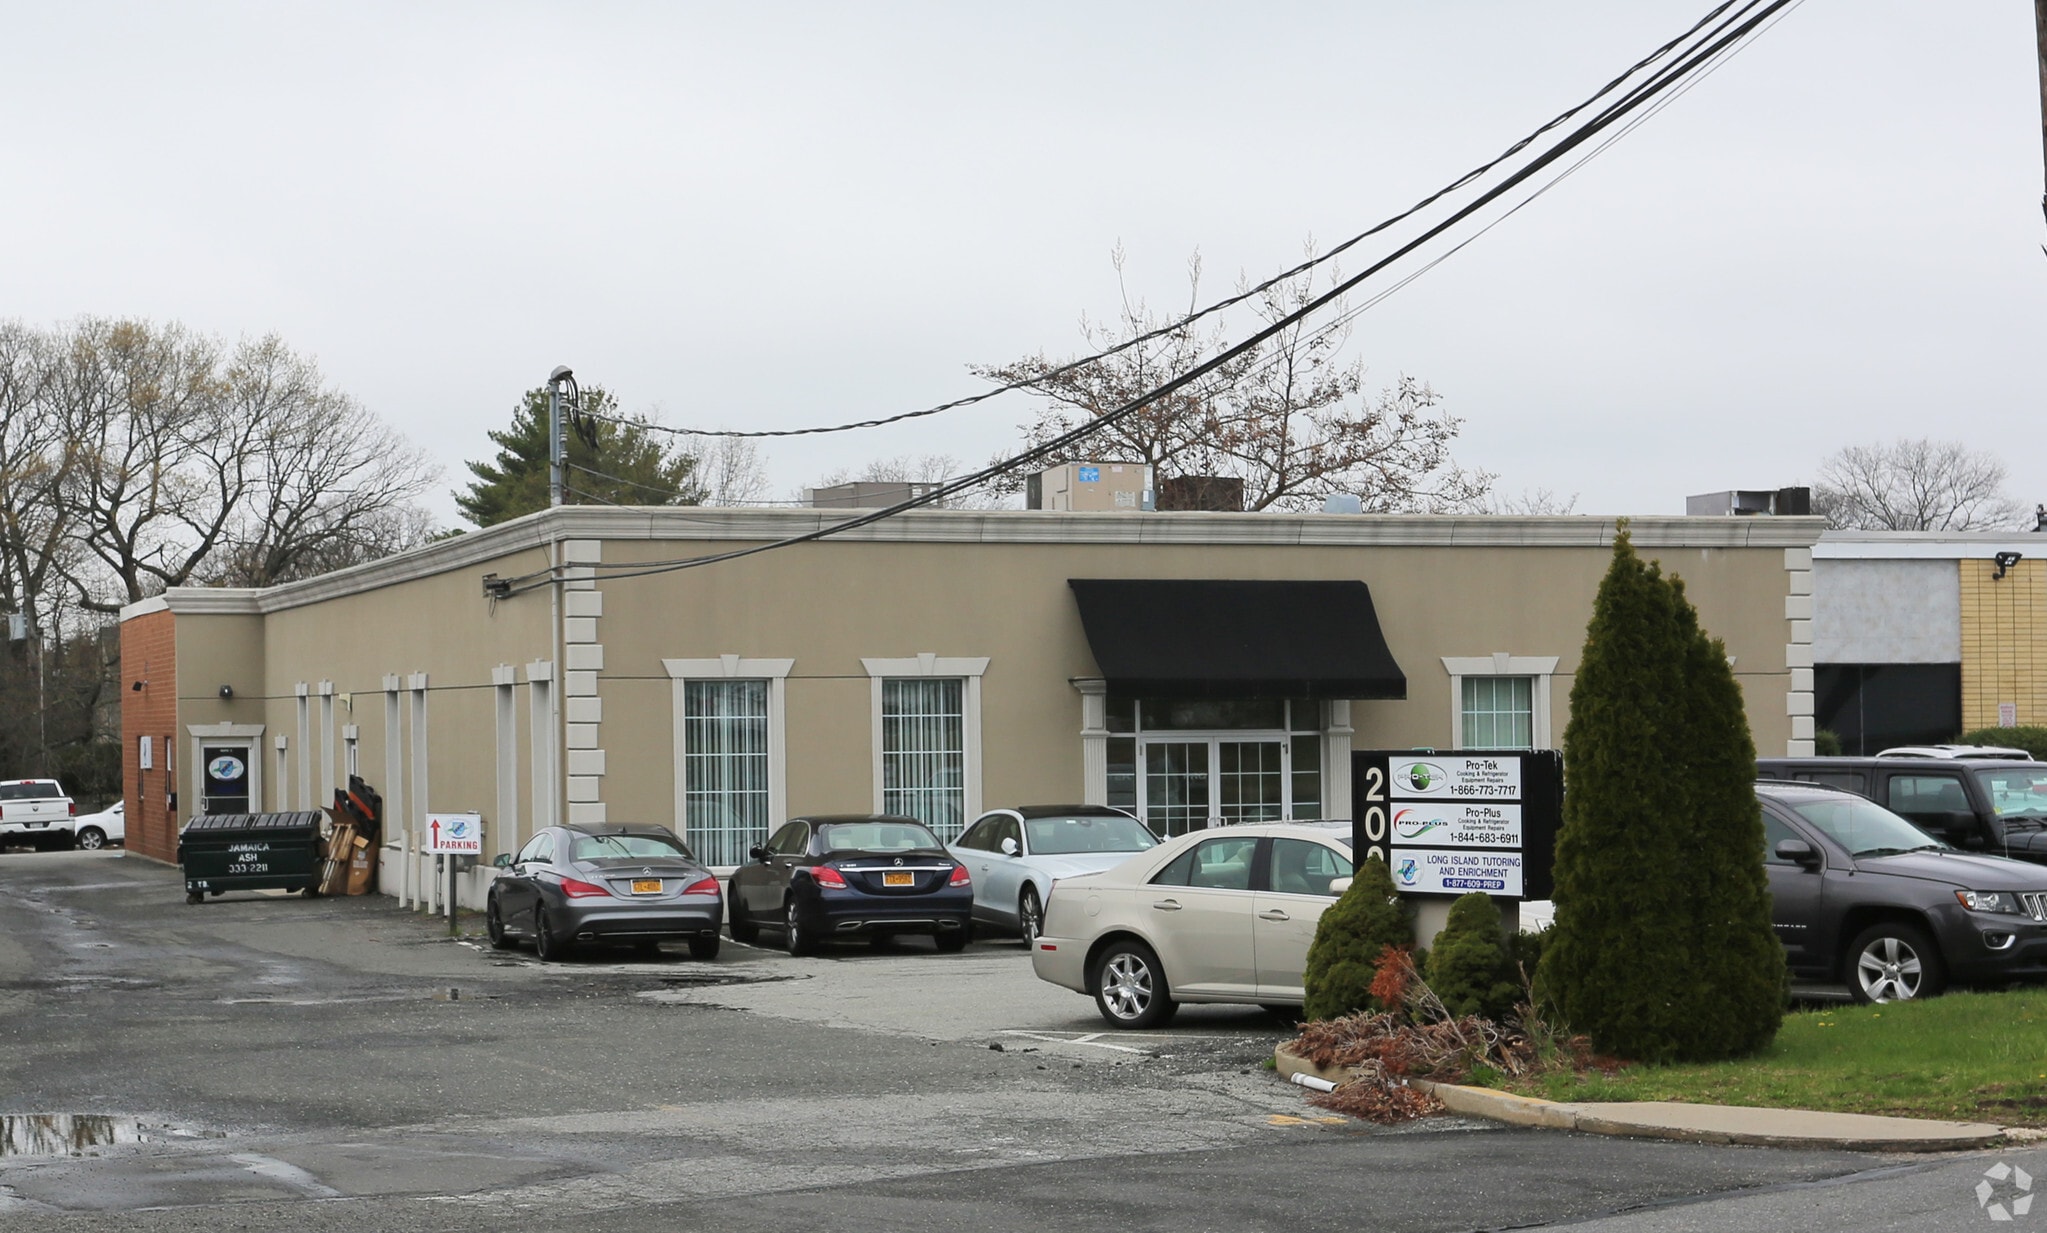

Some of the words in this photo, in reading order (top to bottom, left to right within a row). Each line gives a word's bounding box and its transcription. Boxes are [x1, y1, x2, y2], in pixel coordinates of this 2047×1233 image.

[1466, 760, 1498, 770] Pro-Tek
[1450, 785, 1517, 795] 1-866-773-7717
[1466, 807, 1501, 818] Pro-Plus
[1450, 832, 1518, 843] 1-844-683-6911
[228, 843, 269, 852] JAMAICA
[440, 841, 478, 849] PARKING
[238, 853, 257, 862] ASH
[1427, 855, 1448, 864] LONG
[1451, 856, 1479, 865] ISLAND
[1483, 857, 1521, 867] TUTORING
[228, 864, 268, 873] 333-2211
[1439, 867, 1455, 876] AND
[1458, 868, 1508, 878] ENRICHMENT
[1446, 879, 1502, 888] 1-877-609-PREP
